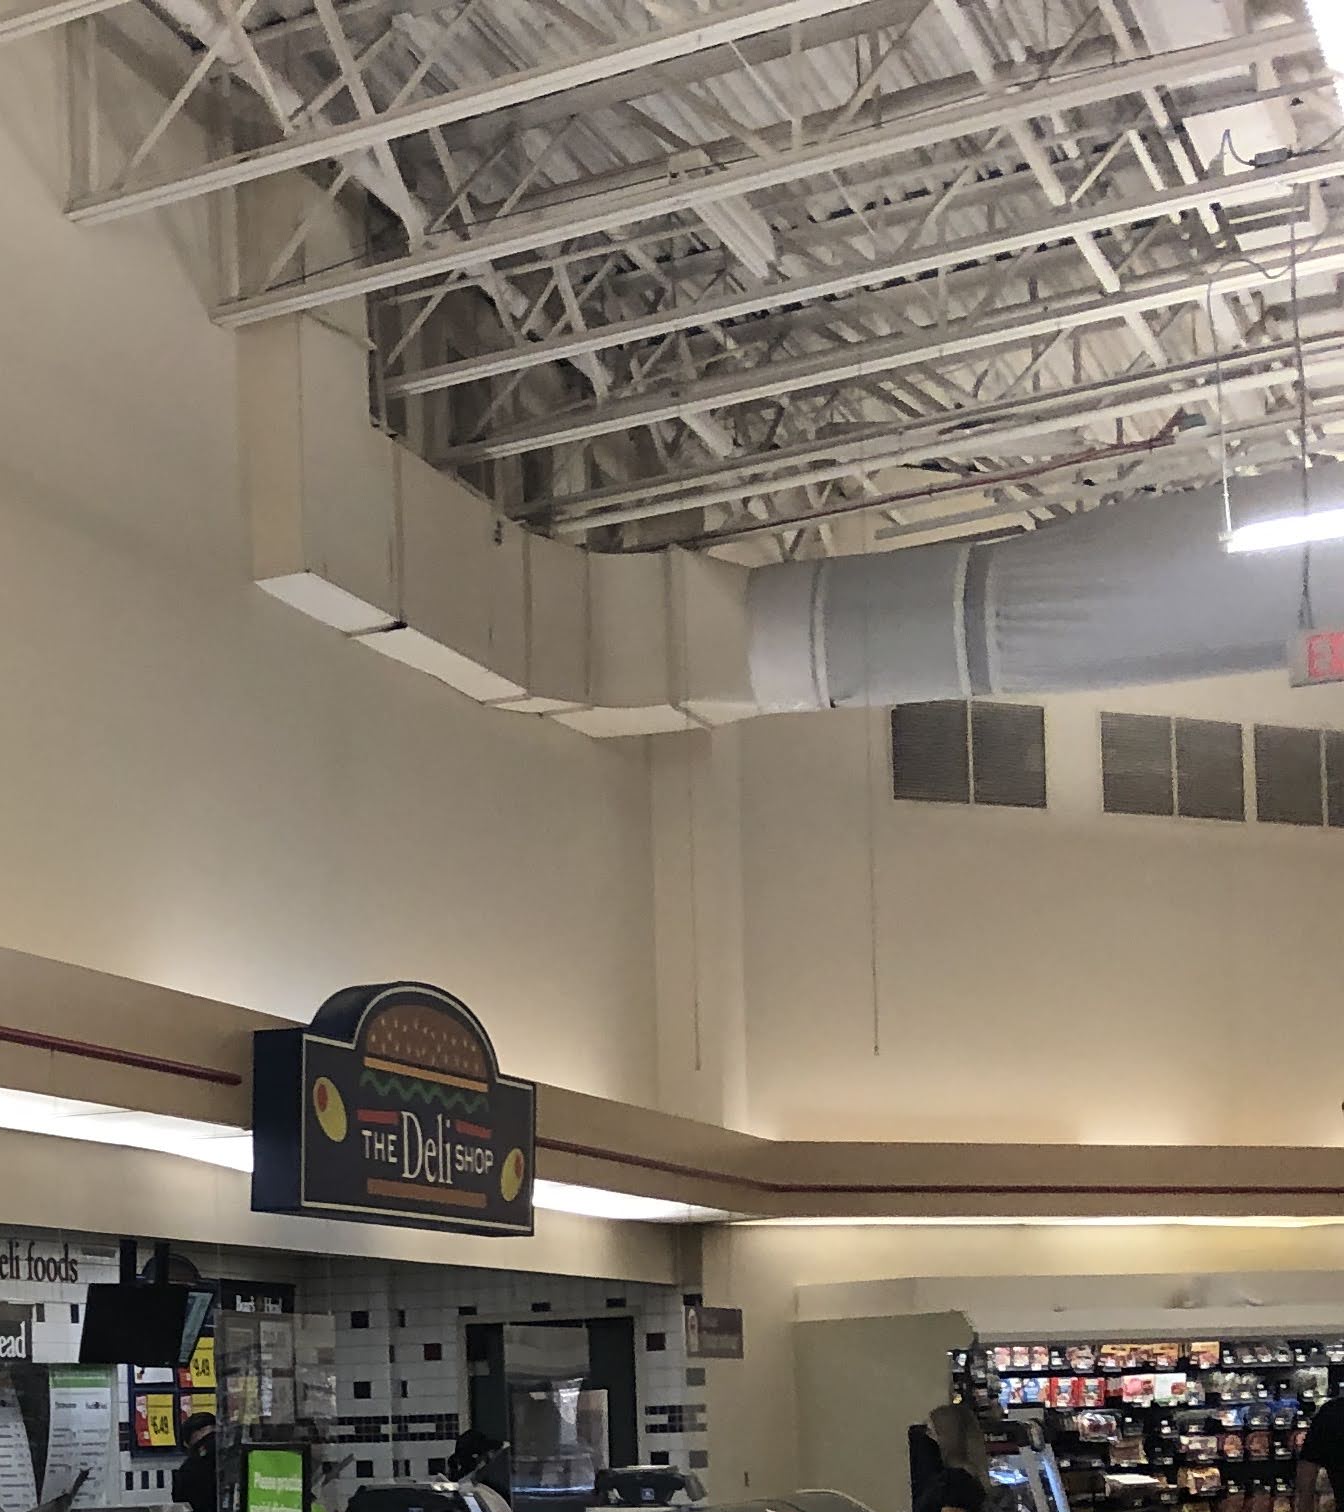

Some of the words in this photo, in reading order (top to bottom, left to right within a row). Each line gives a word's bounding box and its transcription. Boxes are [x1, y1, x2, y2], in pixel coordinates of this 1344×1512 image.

[360, 1128, 399, 1166] THE
[400, 1110, 455, 1186] Deli
[454, 1143, 495, 1176] SHOP
[26, 1243, 79, 1283] foods
